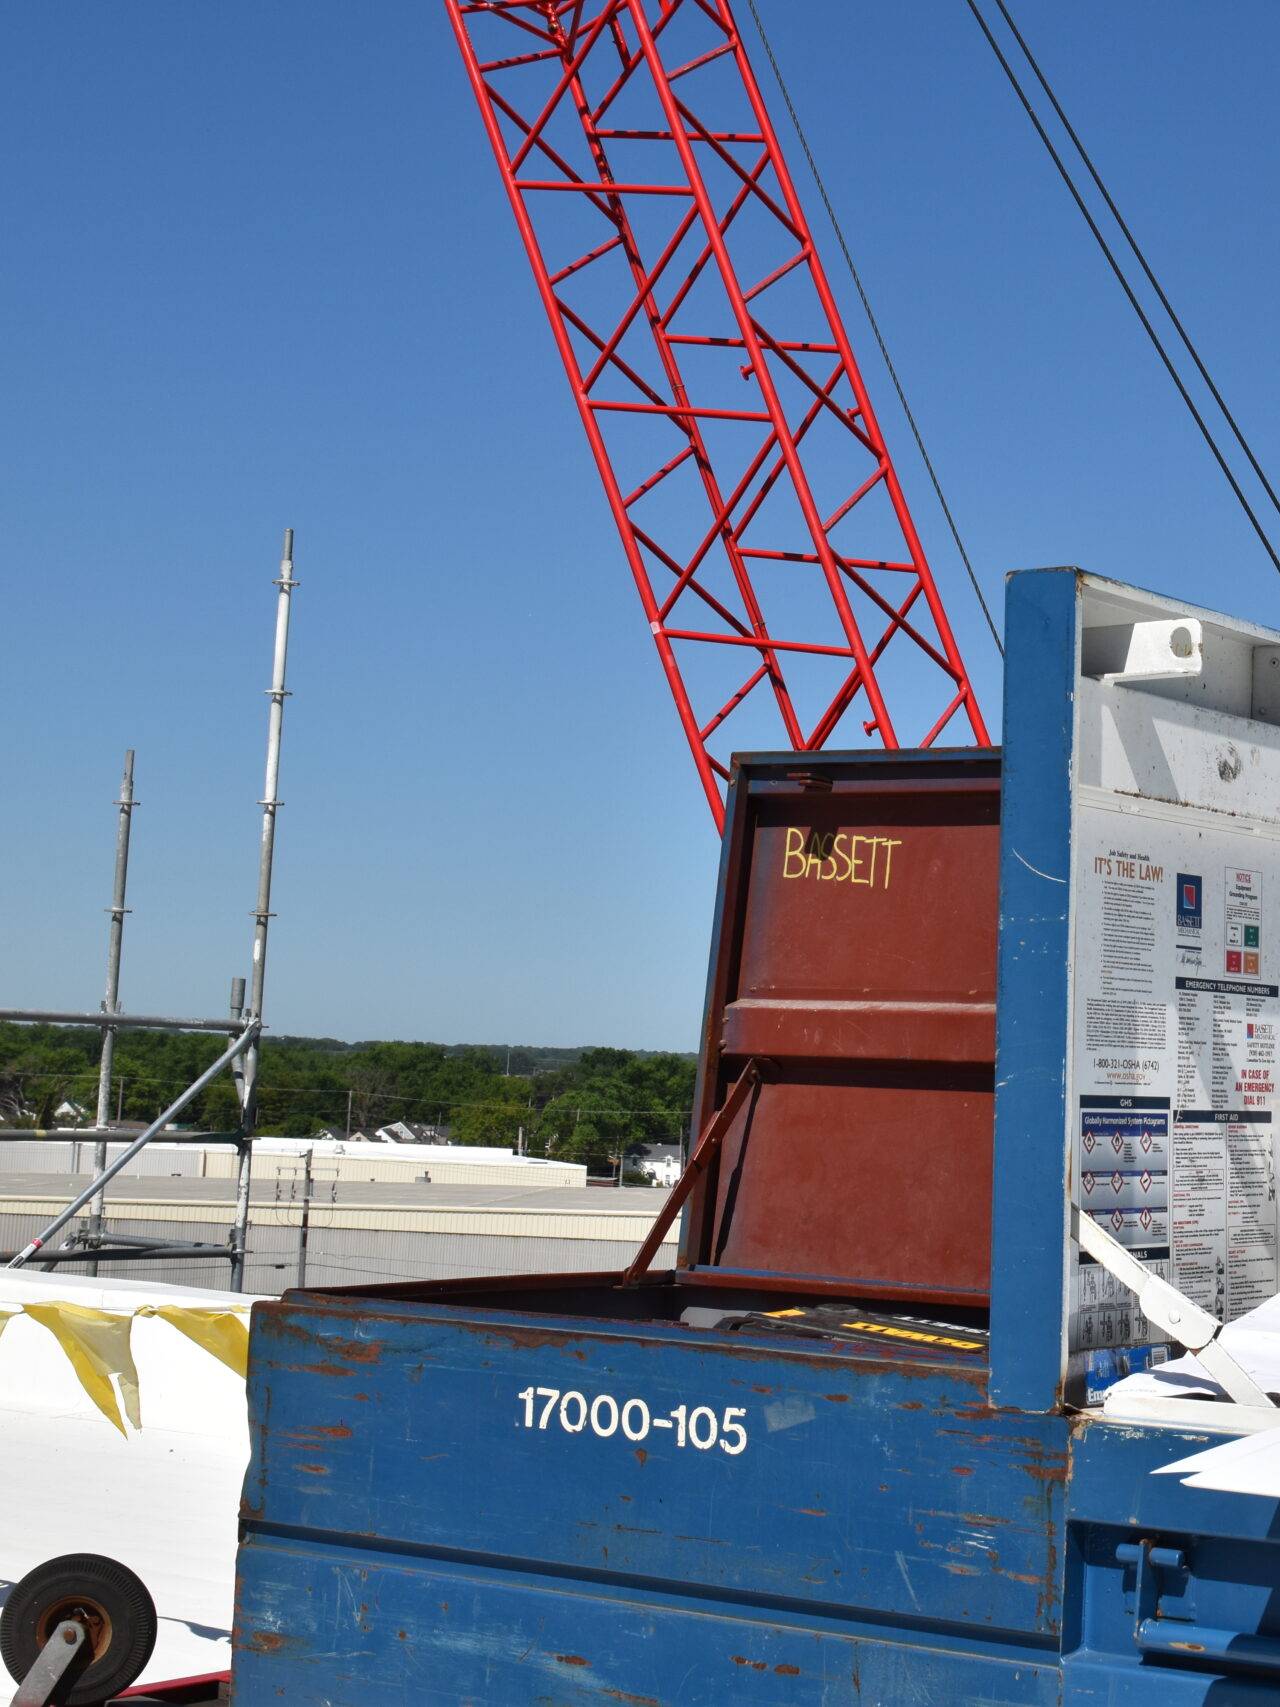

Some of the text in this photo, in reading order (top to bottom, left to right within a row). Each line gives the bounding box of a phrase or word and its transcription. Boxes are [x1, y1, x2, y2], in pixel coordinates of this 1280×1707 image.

[783, 828, 902, 889] BASSETT
[1117, 850, 1129, 860] Safety
[1094, 856, 1164, 883] IT'S THE LAW!
[1236, 873, 1251, 883] NOTICE
[1229, 891, 1258, 901] Grounding Program
[1177, 914, 1201, 927] BASSETT
[1186, 980, 1270, 995] EMERGENCY TELEPHONE NUMBERS
[1254, 1024, 1273, 1034] BASSETT
[1094, 1058, 1160, 1072] 1-800-321-OSHA (6742)
[1107, 1071, 1146, 1083] www.osha.gov
[1242, 1070, 1270, 1080] IN CASE OF
[1235, 1082, 1275, 1093] AN EMERGENCY
[1120, 1099, 1132, 1107] GHS
[1244, 1096, 1266, 1105] DIAL 911
[1084, 1116, 1166, 1127] Globally Harmonized System Pictograms
[892, 1316, 990, 1336] SSETT
[518, 1387, 747, 1455] 17000-105
